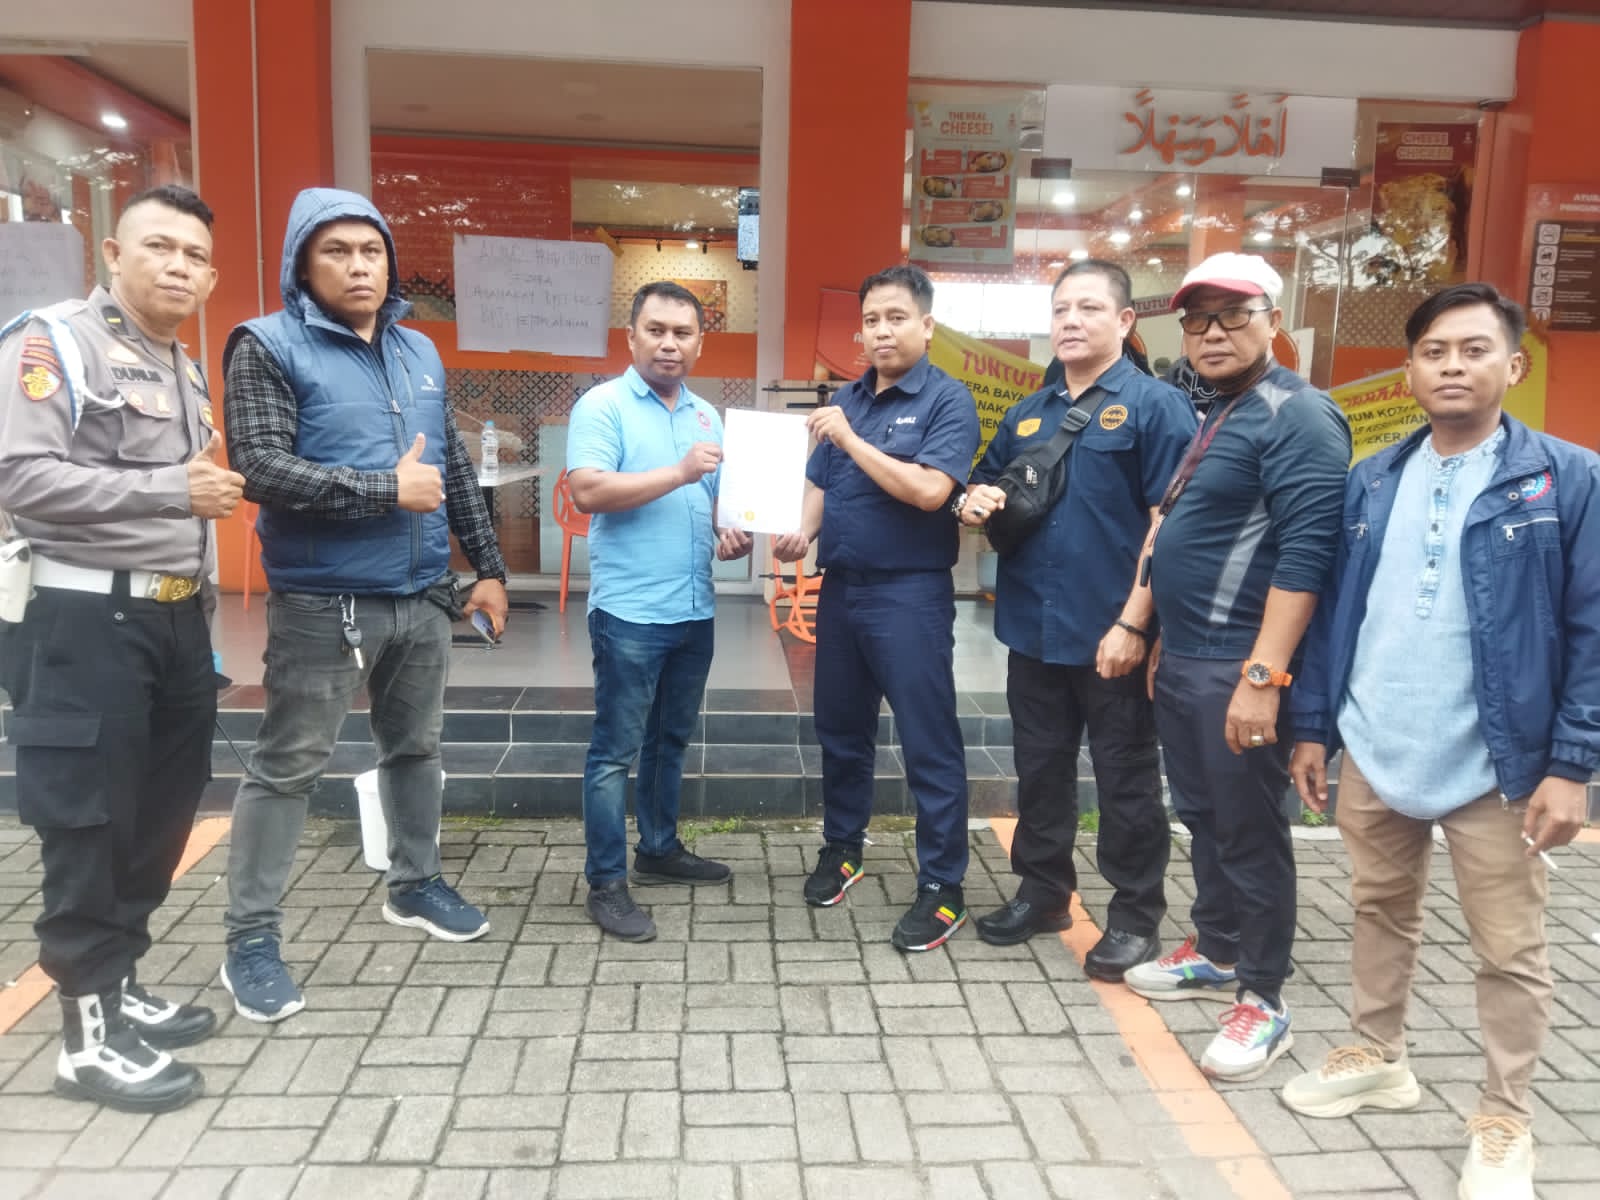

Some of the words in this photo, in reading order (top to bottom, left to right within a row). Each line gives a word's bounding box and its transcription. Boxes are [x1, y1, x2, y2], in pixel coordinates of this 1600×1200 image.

[948, 112, 965, 121] THE
[940, 121, 993, 135] CHEESE!
[961, 378, 990, 395] ERA
